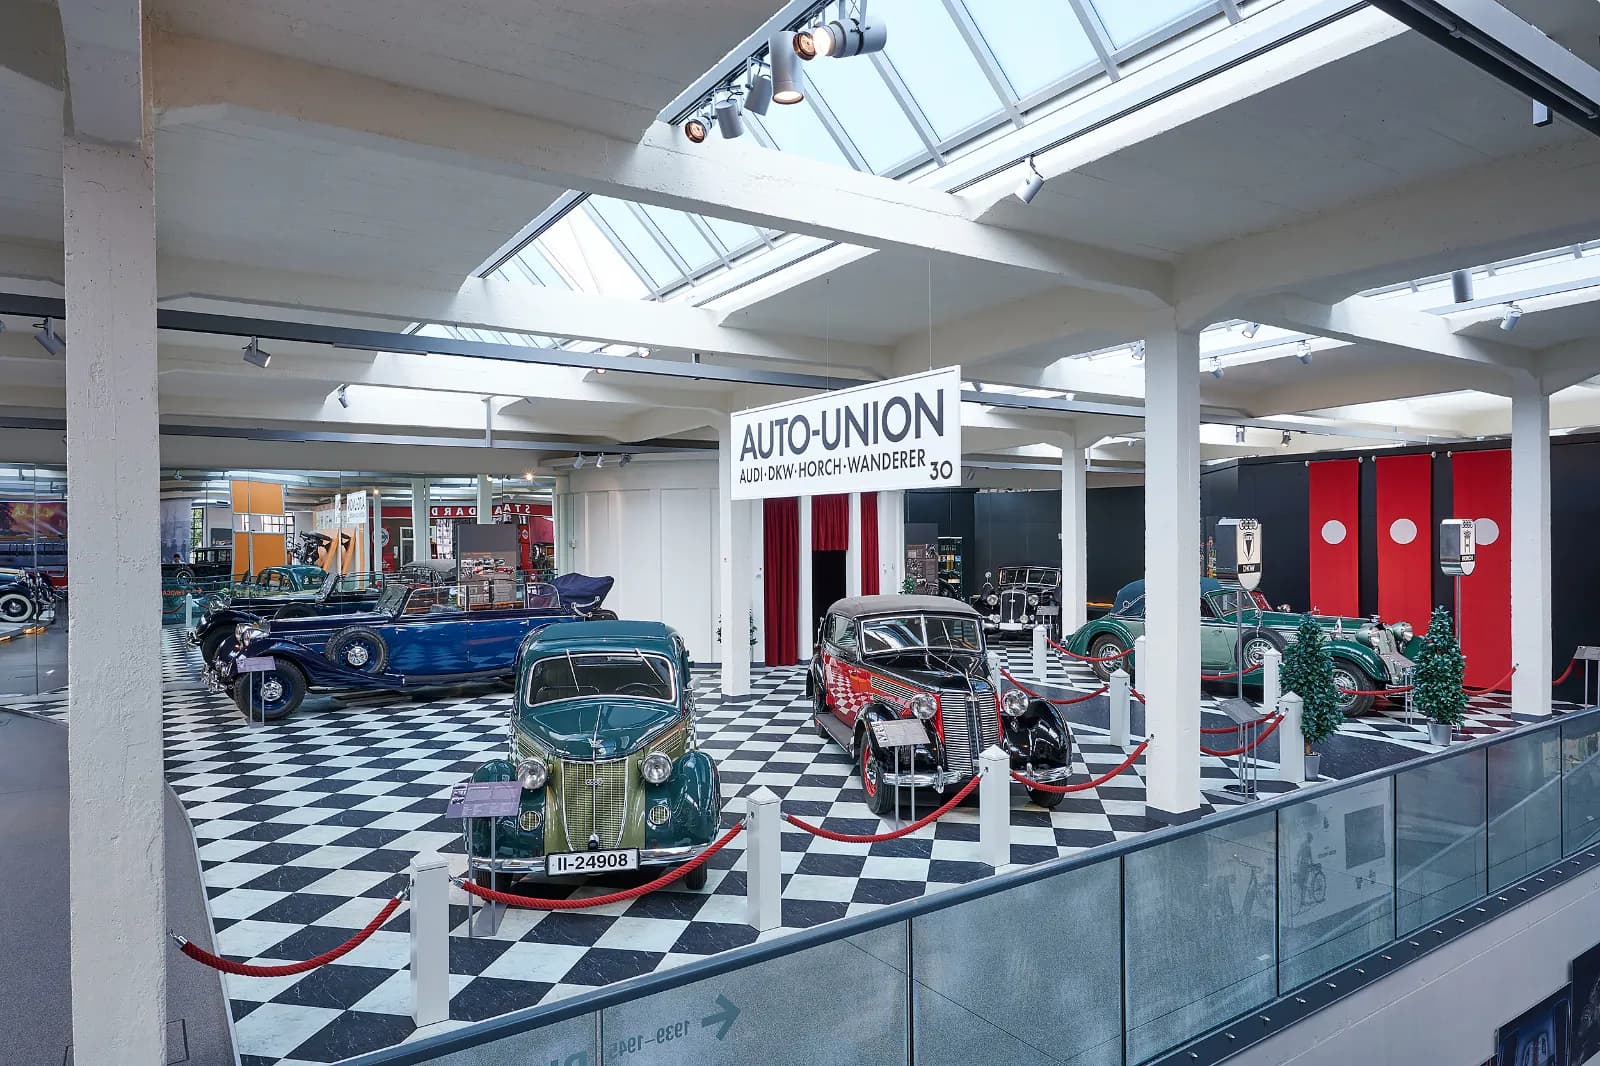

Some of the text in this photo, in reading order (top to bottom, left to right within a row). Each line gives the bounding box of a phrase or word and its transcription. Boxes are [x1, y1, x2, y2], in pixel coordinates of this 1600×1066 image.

[739, 388, 944, 462] AUTO-UNION
[739, 448, 926, 484] AUDI DKW HORCH WANDERER
[929, 460, 953, 481] 30
